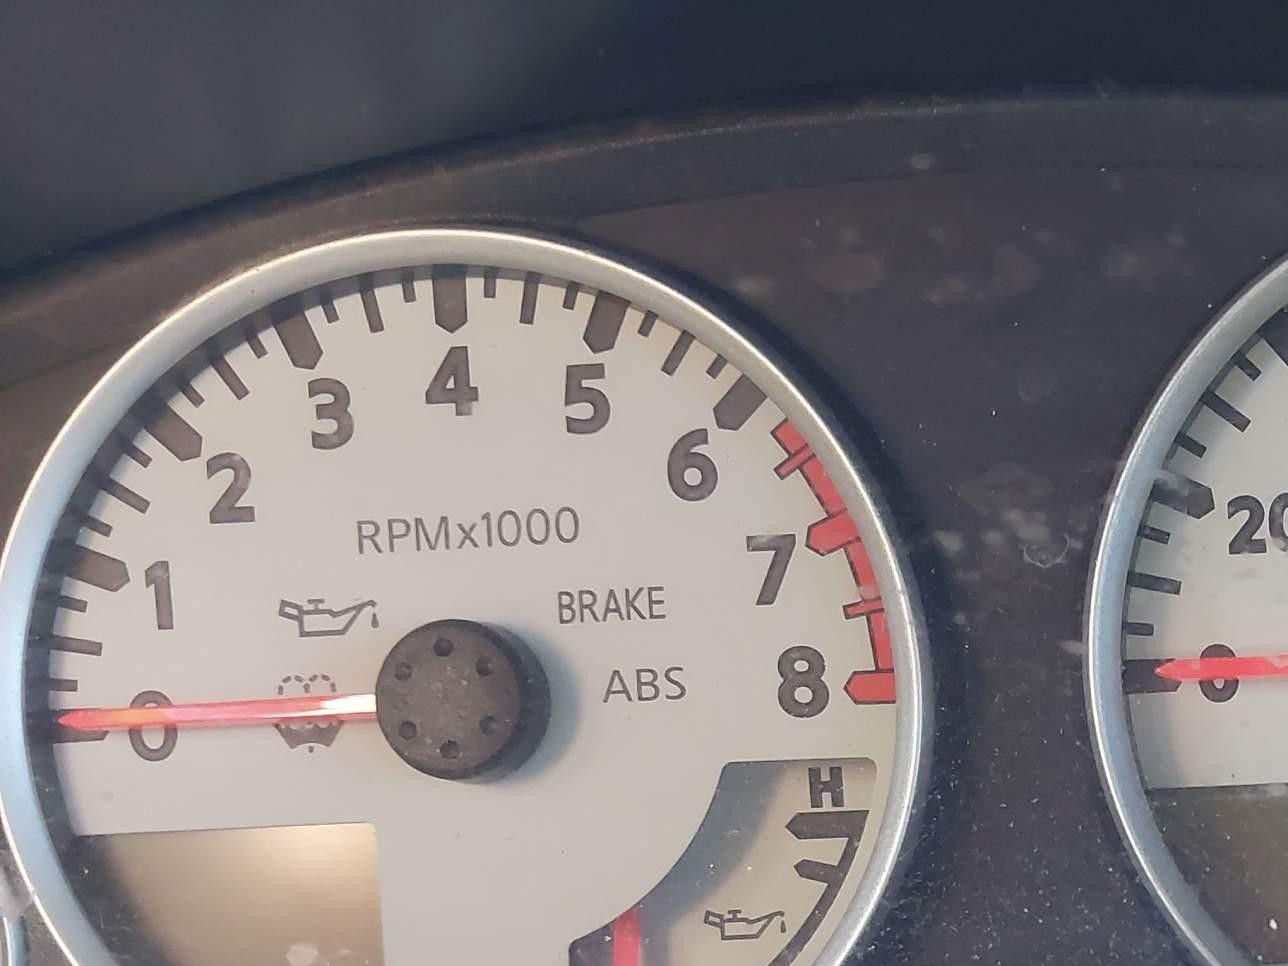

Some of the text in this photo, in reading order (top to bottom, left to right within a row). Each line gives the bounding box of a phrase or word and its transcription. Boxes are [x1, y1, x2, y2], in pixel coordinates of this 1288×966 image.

[307, 377, 355, 451] 3
[424, 345, 479, 417] 4
[563, 362, 612, 436] 5
[205, 451, 256, 525] 2
[666, 427, 720, 502] 6
[356, 506, 581, 555] RPMx1000
[144, 560, 174, 631] 1
[745, 533, 797, 606] 7
[557, 586, 667, 626] BRAKE
[602, 666, 688, 704] ABS
[777, 645, 830, 719] 8
[1198, 643, 1240, 703] 0
[128, 690, 178, 762] 0
[808, 766, 845, 809] H
